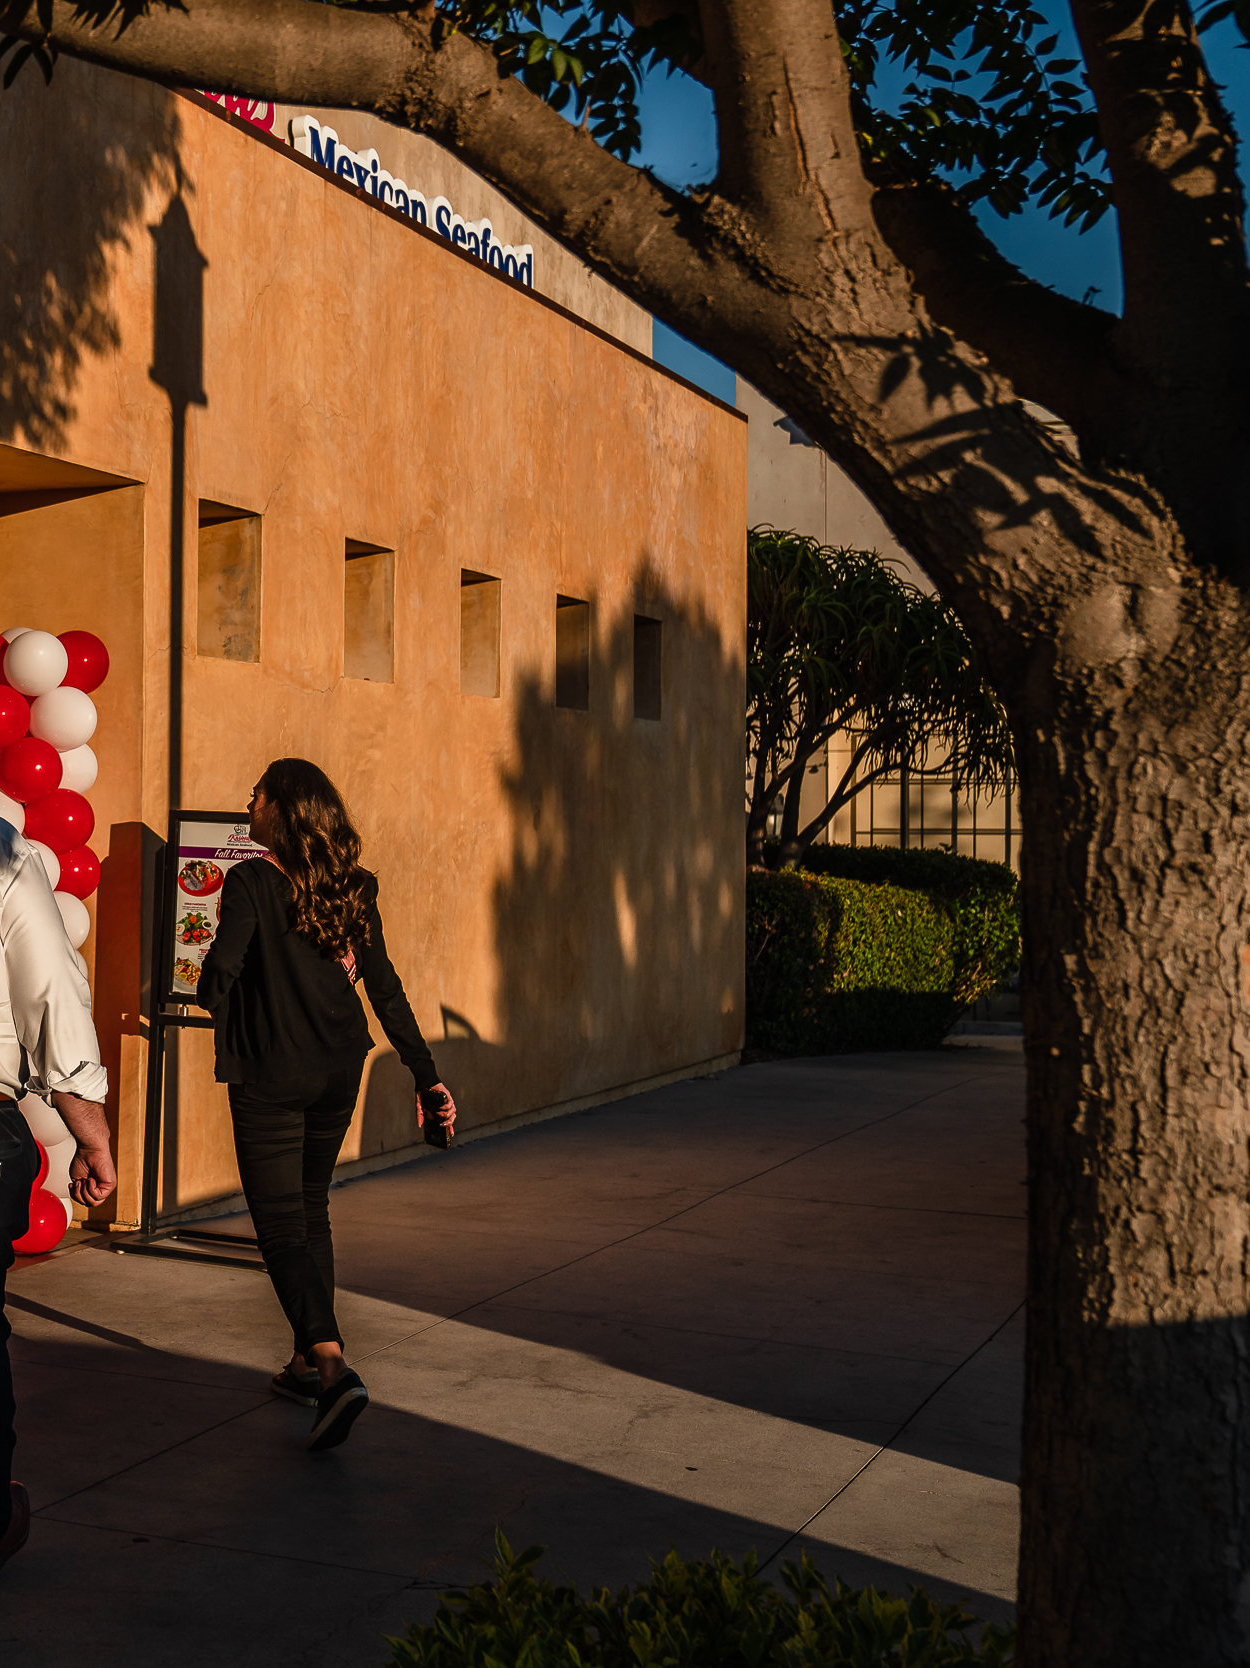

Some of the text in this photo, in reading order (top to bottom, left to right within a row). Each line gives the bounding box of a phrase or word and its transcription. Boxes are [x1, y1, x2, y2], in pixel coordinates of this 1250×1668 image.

[309, 126, 533, 288] Mexican Seafood
[214, 848, 231, 858] Fall
